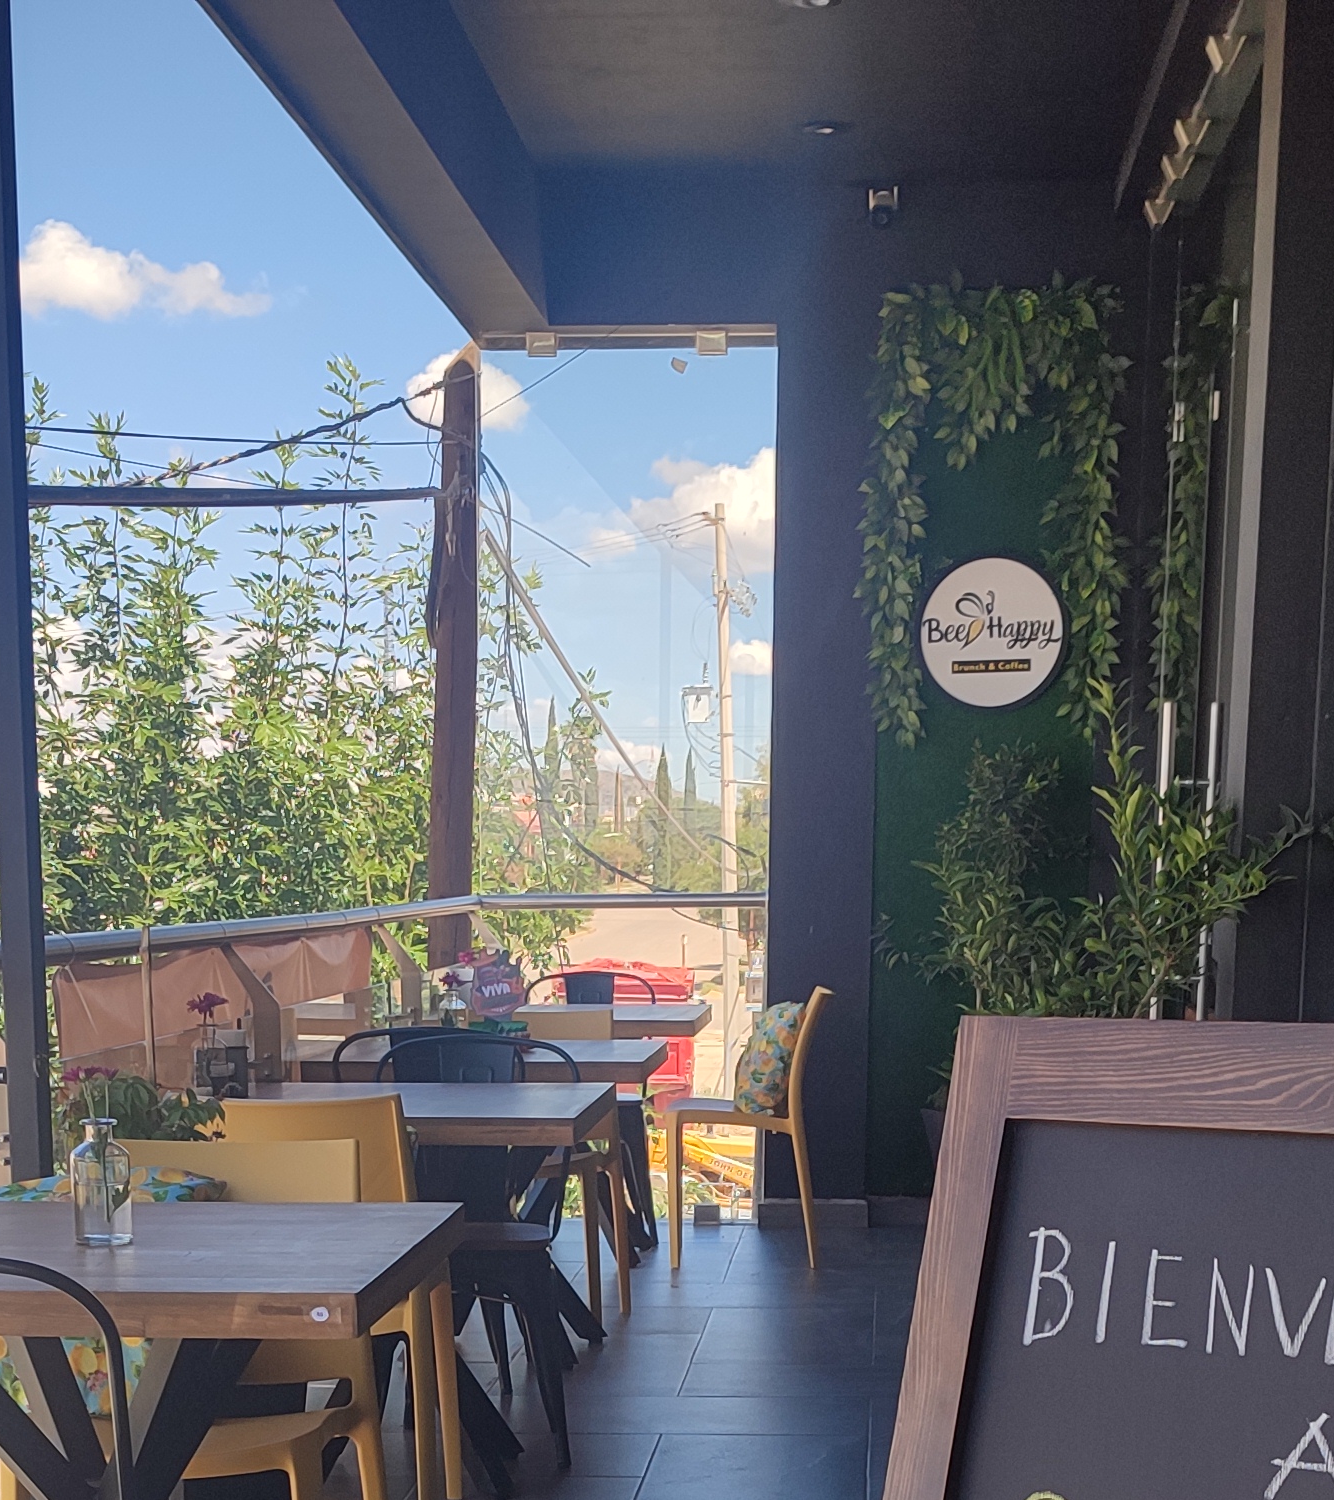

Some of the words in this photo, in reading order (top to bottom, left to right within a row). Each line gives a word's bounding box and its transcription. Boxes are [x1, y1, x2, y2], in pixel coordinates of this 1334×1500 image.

[922, 617, 967, 644] Bee
[987, 615, 1062, 650] Happy
[953, 663, 986, 672] Brunch
[998, 661, 1029, 671] Coffee
